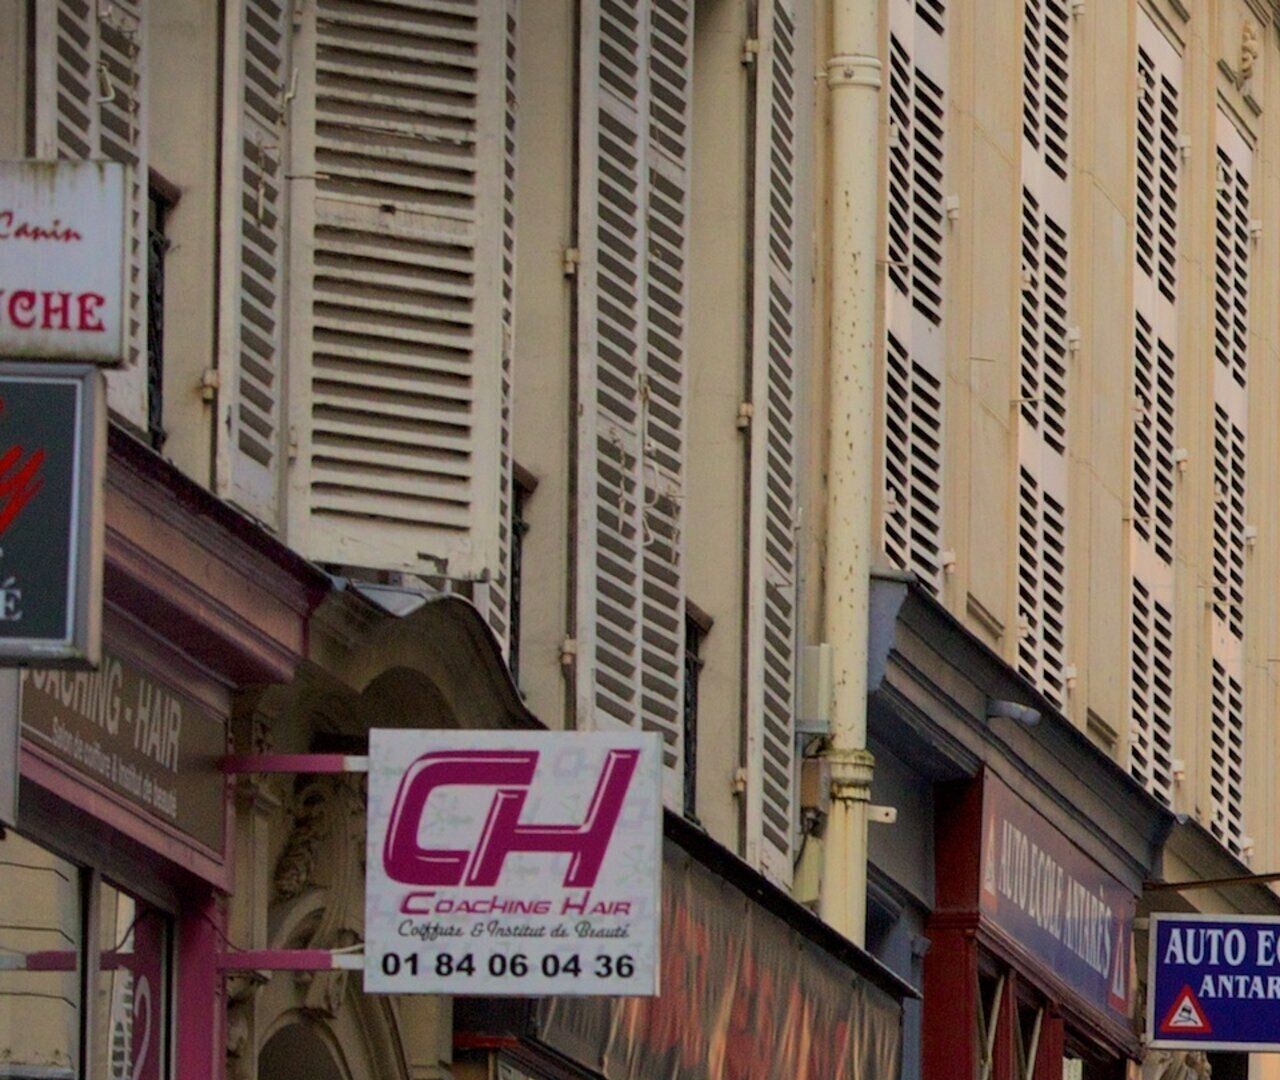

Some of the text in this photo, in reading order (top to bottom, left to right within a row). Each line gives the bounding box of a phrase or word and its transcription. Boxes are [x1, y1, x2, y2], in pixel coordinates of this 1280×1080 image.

[0, 288, 106, 332] CHE
[134, 678, 182, 773] HAIR
[382, 749, 641, 888] CH
[999, 818, 1029, 911] AUTO
[1028, 842, 1064, 941] ECOLE
[398, 919, 630, 941] Coiffure & Institut de Beauté
[1163, 927, 1246, 966] AUTO
[381, 953, 635, 978] 01 84 06 04 36
